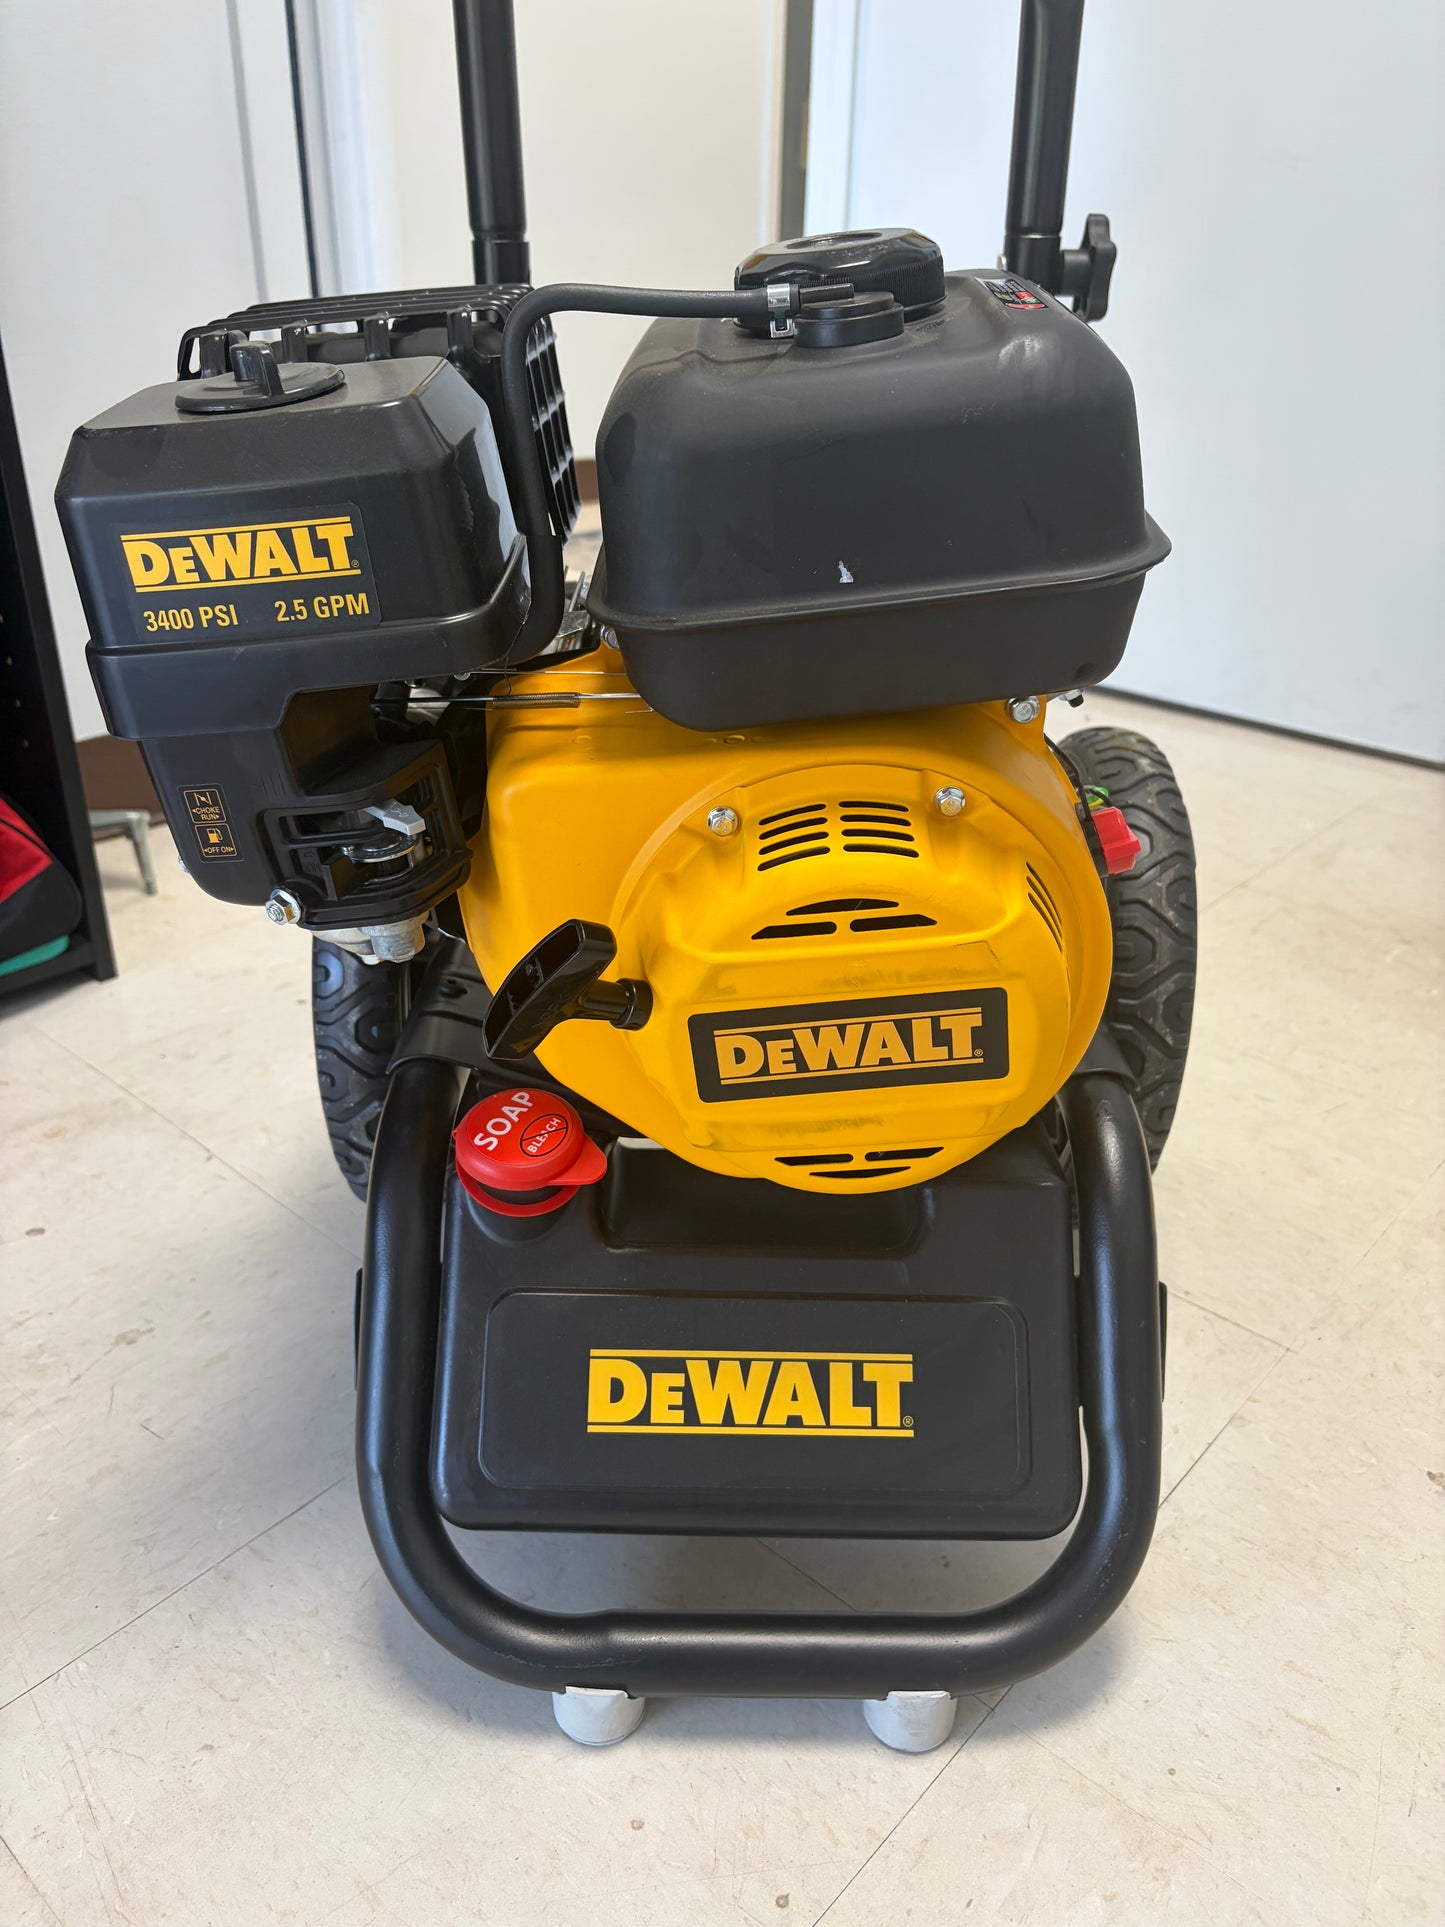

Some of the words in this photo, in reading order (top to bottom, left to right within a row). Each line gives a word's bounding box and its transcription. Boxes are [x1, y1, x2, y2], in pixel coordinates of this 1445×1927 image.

[143, 608, 194, 632] 3400
[199, 604, 239, 628] PSI
[274, 600, 307, 622] 2.5
[313, 592, 370, 619] GPM
[195, 806, 220, 814] CHOKE
[201, 813, 216, 821] RUN
[207, 846, 220, 854] OFF
[473, 1091, 534, 1151] SOAP
